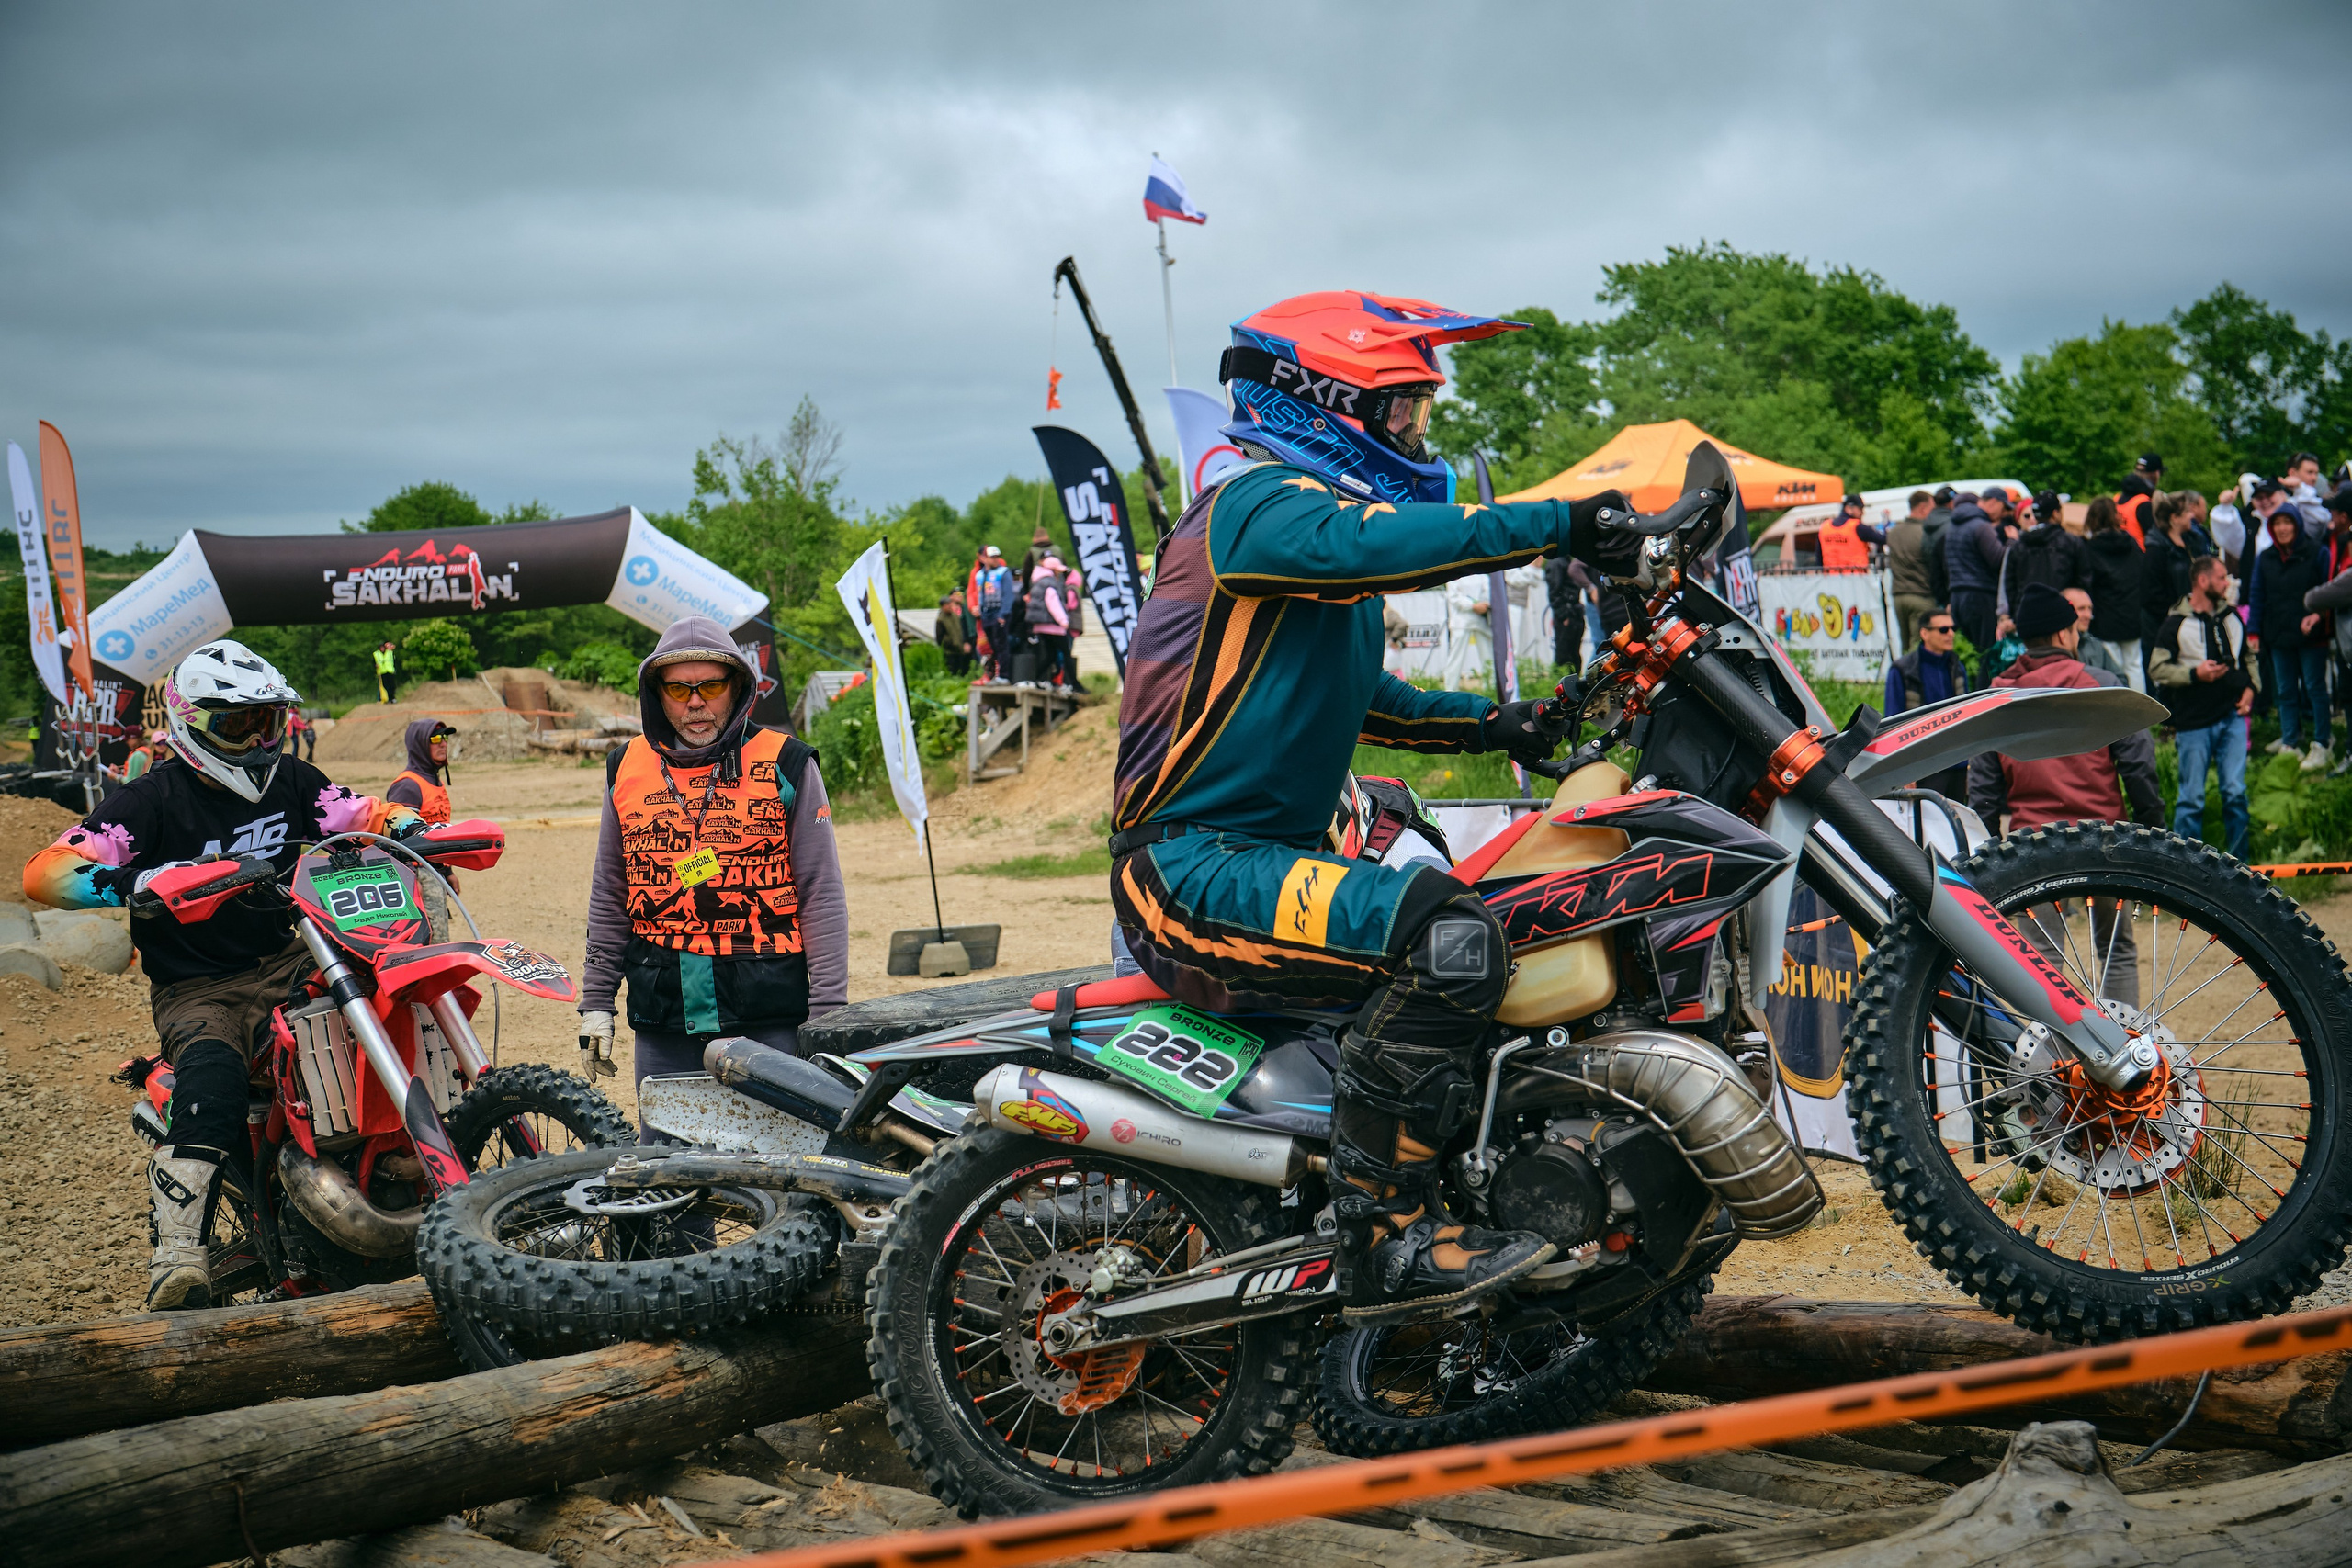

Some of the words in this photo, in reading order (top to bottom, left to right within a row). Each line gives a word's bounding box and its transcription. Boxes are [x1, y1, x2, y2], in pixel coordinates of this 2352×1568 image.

[1270, 358, 1361, 414] FXR
[1776, 481, 1815, 494] KTM
[347, 564, 446, 582] ENDURO
[129, 577, 212, 637] МареМед
[1898, 707, 1963, 743] DUNLOP
[336, 872, 382, 885] BRONZE
[684, 854, 713, 874] OFFICIAL
[328, 881, 406, 919] 206
[1505, 853, 1713, 946] KTM
[355, 915, 376, 925] Рада
[377, 910, 408, 919] Николай
[717, 919, 741, 932] PARK
[1440, 930, 1456, 946] F
[1465, 949, 1481, 966] H
[1973, 902, 2086, 1006] DUNLOP
[1170, 1011, 1236, 1046] BRONZE
[1113, 1021, 1238, 1093] 222
[1111, 1055, 1156, 1081] Сухович
[1157, 1077, 1197, 1103] Сергей
[1000, 1100, 1078, 1132] FMF
[1136, 1131, 1182, 1146] ICHIRO
[1243, 1258, 1330, 1299] WP
[2154, 1274, 2231, 1296] X-GRIP
